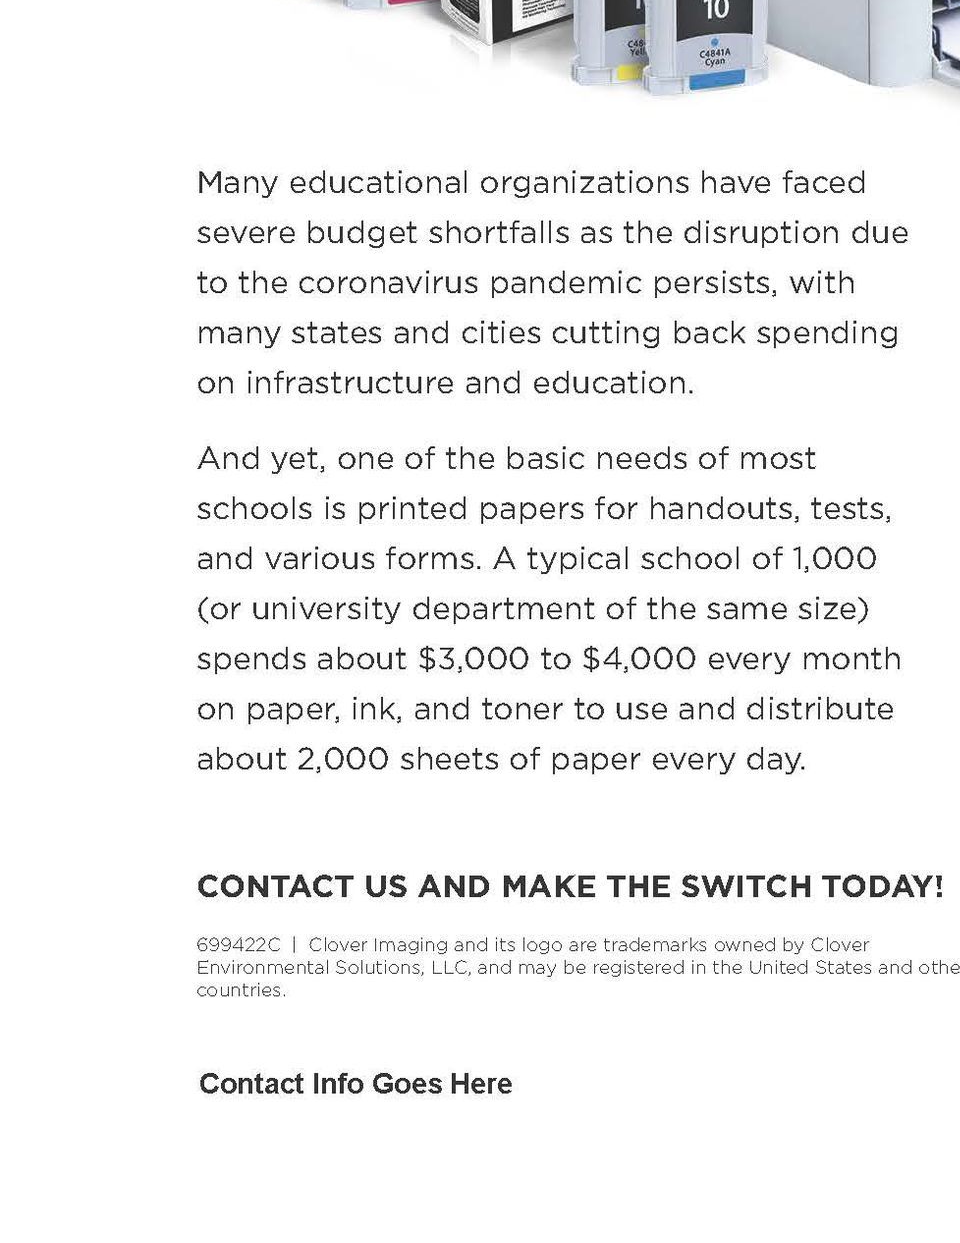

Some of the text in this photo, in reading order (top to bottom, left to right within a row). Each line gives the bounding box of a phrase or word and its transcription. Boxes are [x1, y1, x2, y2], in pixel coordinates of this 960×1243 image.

[627, 39, 646, 48] C48
[699, 48, 731, 59] C4841A
[704, 58, 726, 68] Cyan
[198, 169, 865, 199] Many educational organizations have faced
[196, 219, 909, 249] severe budget shortfalls as the disruption due
[197, 645, 901, 675] spends about $3,000 to $4,000 every month
[197, 873, 943, 898] CONTACT US AND MAKE THE SWITCH TODAY!
[196, 936, 870, 955] 699422C Clover Imaging and its logo are trademarks owned by Clover
[196, 982, 286, 998] countries.
[199, 1072, 513, 1095] Contact Info Goes Here
